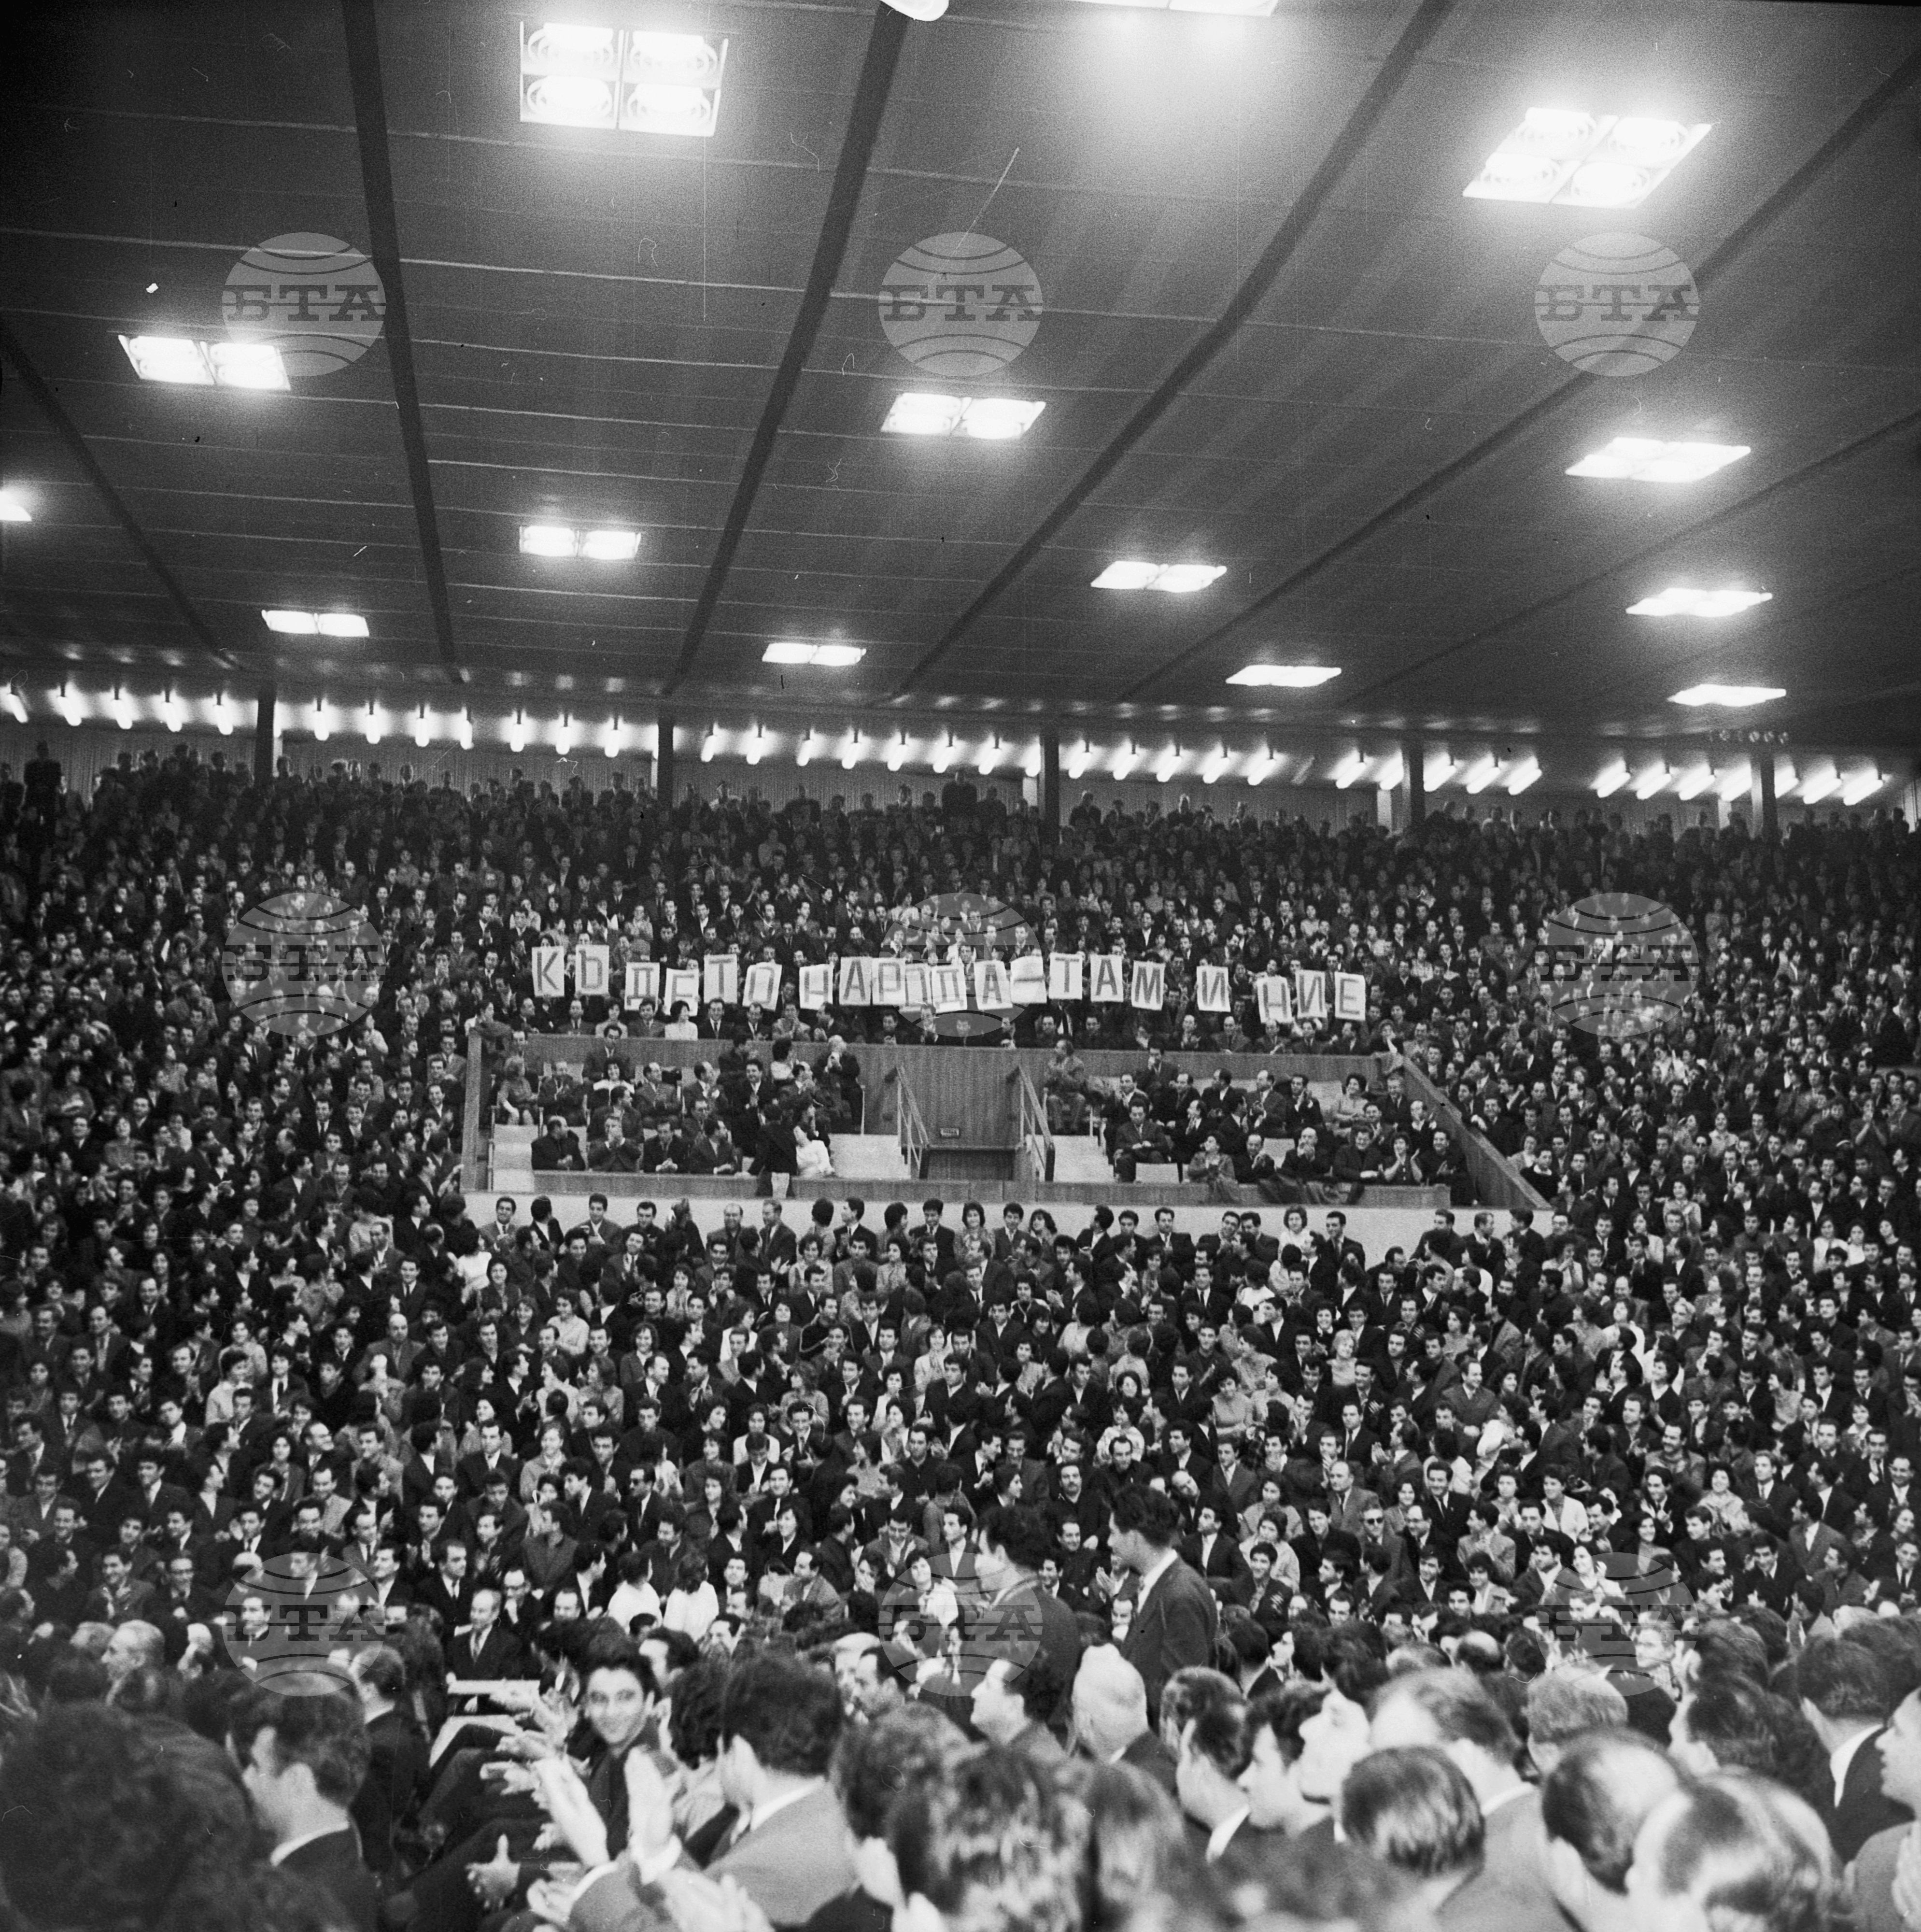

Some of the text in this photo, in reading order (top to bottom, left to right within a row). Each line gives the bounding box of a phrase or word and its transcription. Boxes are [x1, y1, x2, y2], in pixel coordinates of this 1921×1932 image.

[1055, 957, 1161, 1004] ТАМ
[1201, 970, 1226, 1008] И
[1262, 974, 1360, 1018] НИЕ
